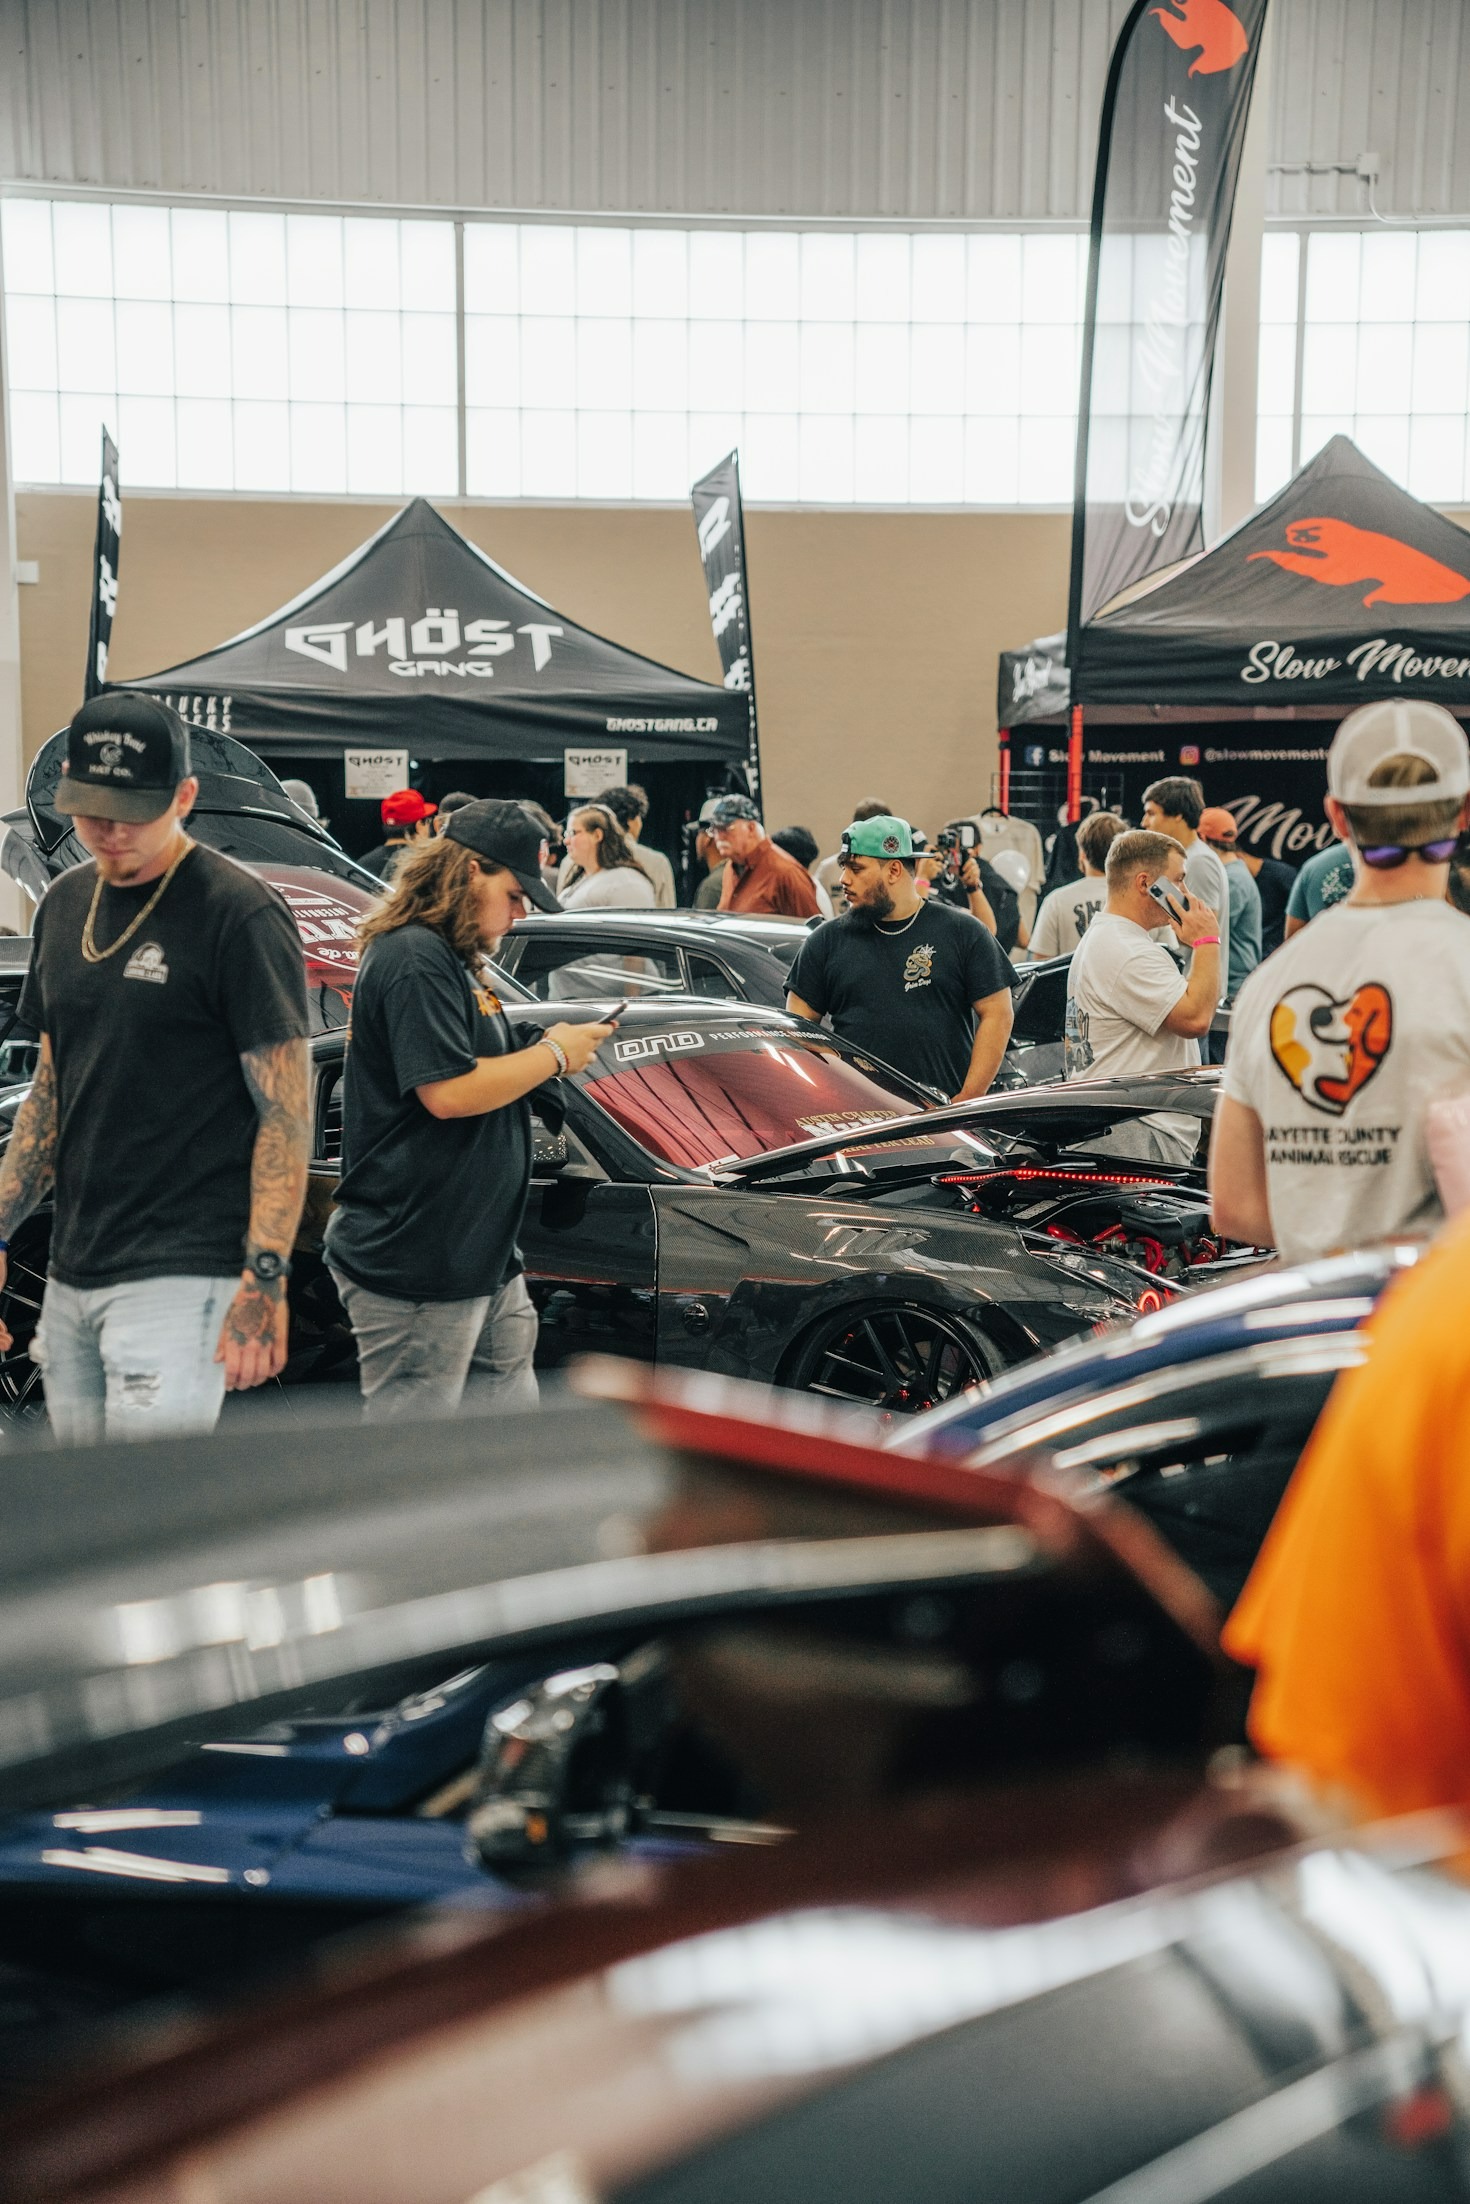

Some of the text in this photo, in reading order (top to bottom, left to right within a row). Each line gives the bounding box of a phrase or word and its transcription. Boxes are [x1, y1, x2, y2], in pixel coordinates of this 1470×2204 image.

[1137, 94, 1203, 392] Movement
[388, 660, 493, 678] GANG
[1240, 640, 1342, 684] Slow
[606, 717, 718, 732] GHOSTGANG.CA
[1088, 749, 1165, 763] Movement
[709, 1030, 790, 1041] PERFORMANCE
[795, 1110, 898, 1127] AUSTIN CHAPTER
